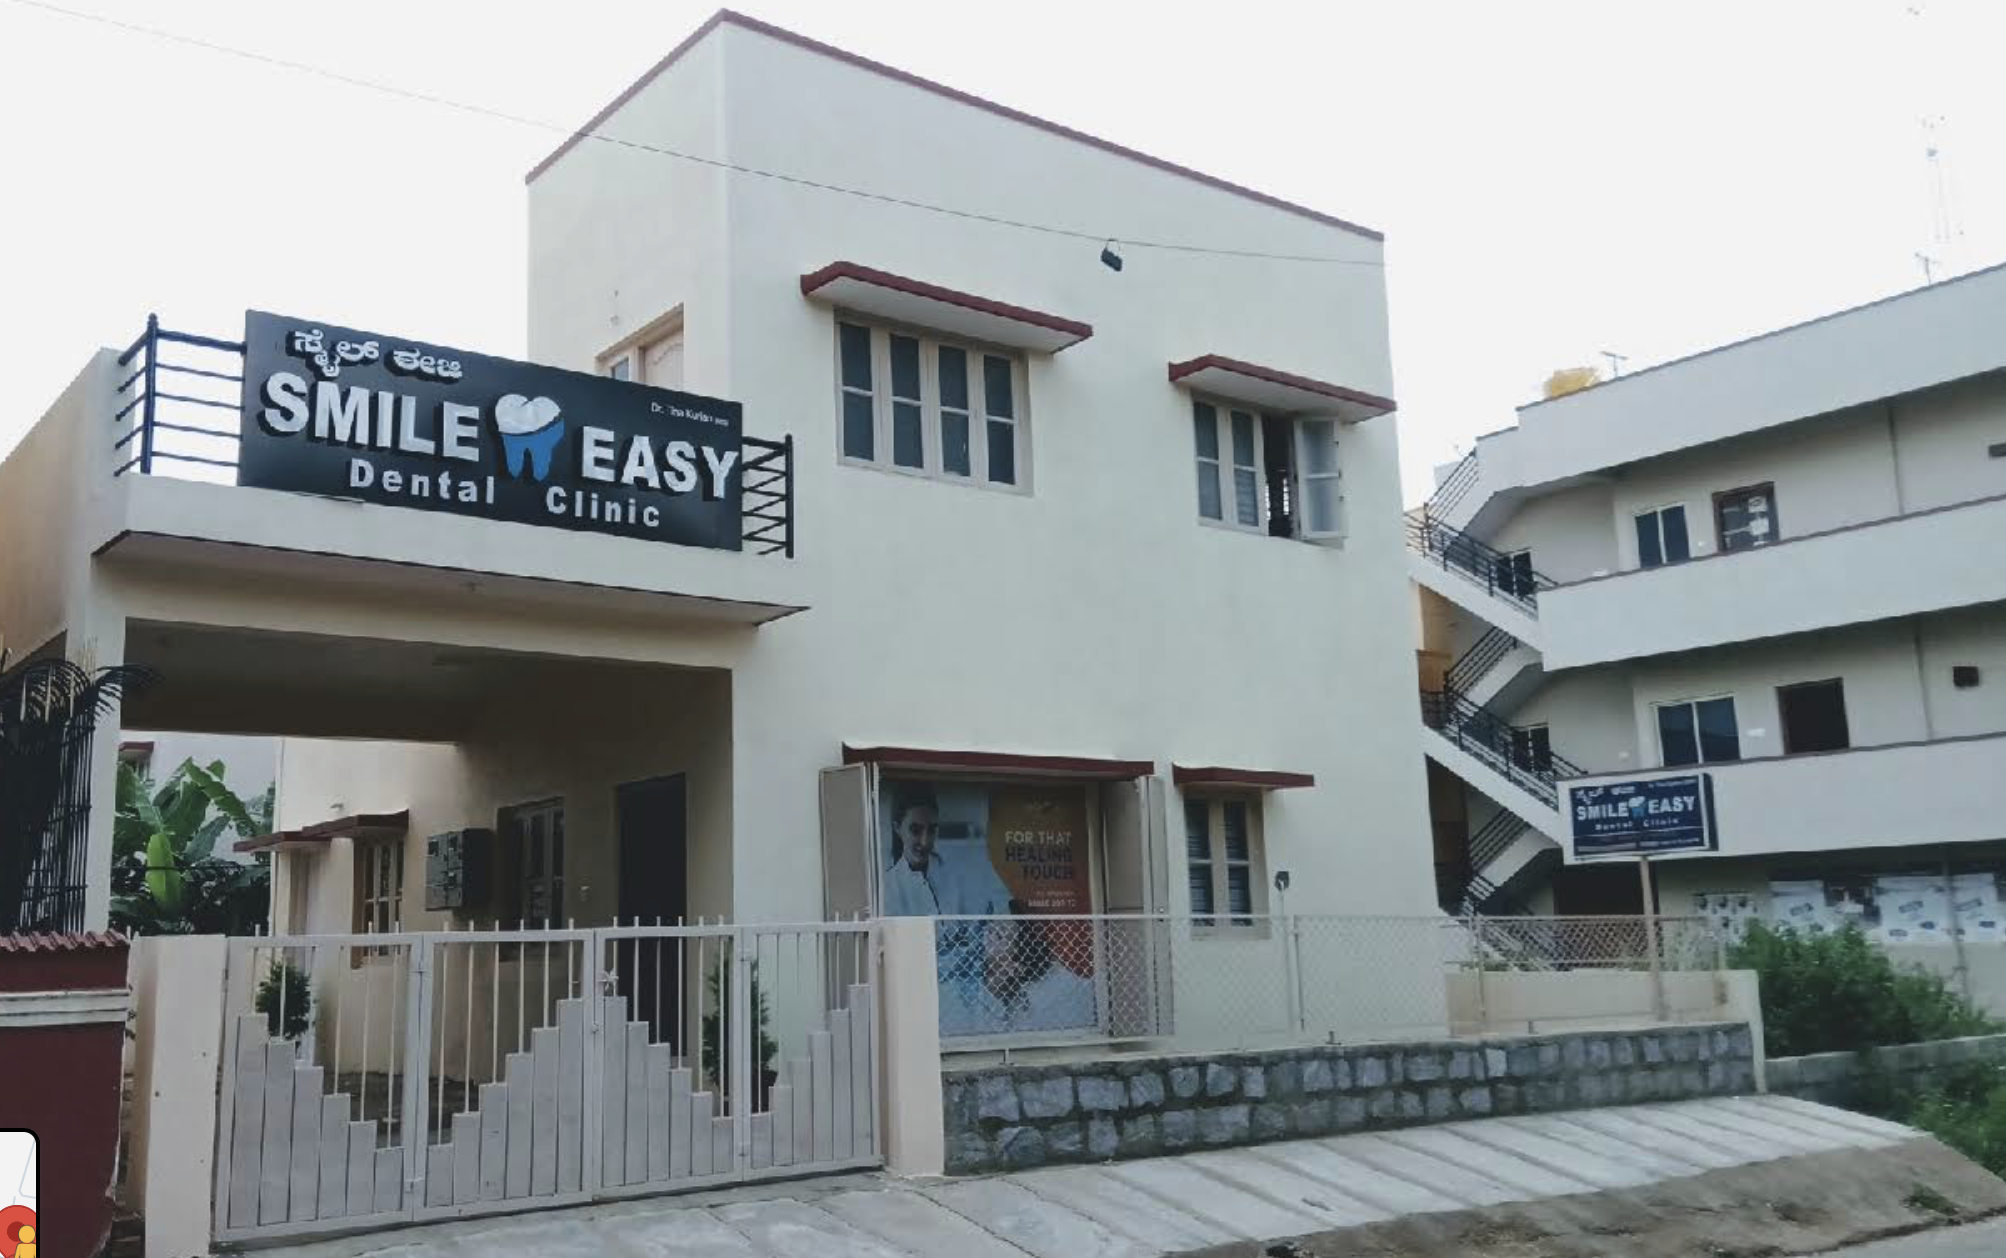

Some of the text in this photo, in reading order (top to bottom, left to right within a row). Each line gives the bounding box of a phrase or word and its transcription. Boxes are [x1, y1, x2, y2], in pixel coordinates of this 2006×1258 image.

[264, 371, 739, 500] SMILE EASY
[350, 458, 660, 528] Dental Clinic
[1576, 795, 1695, 821] SMILE EASY
[1005, 830, 1073, 845] FOR THAT
